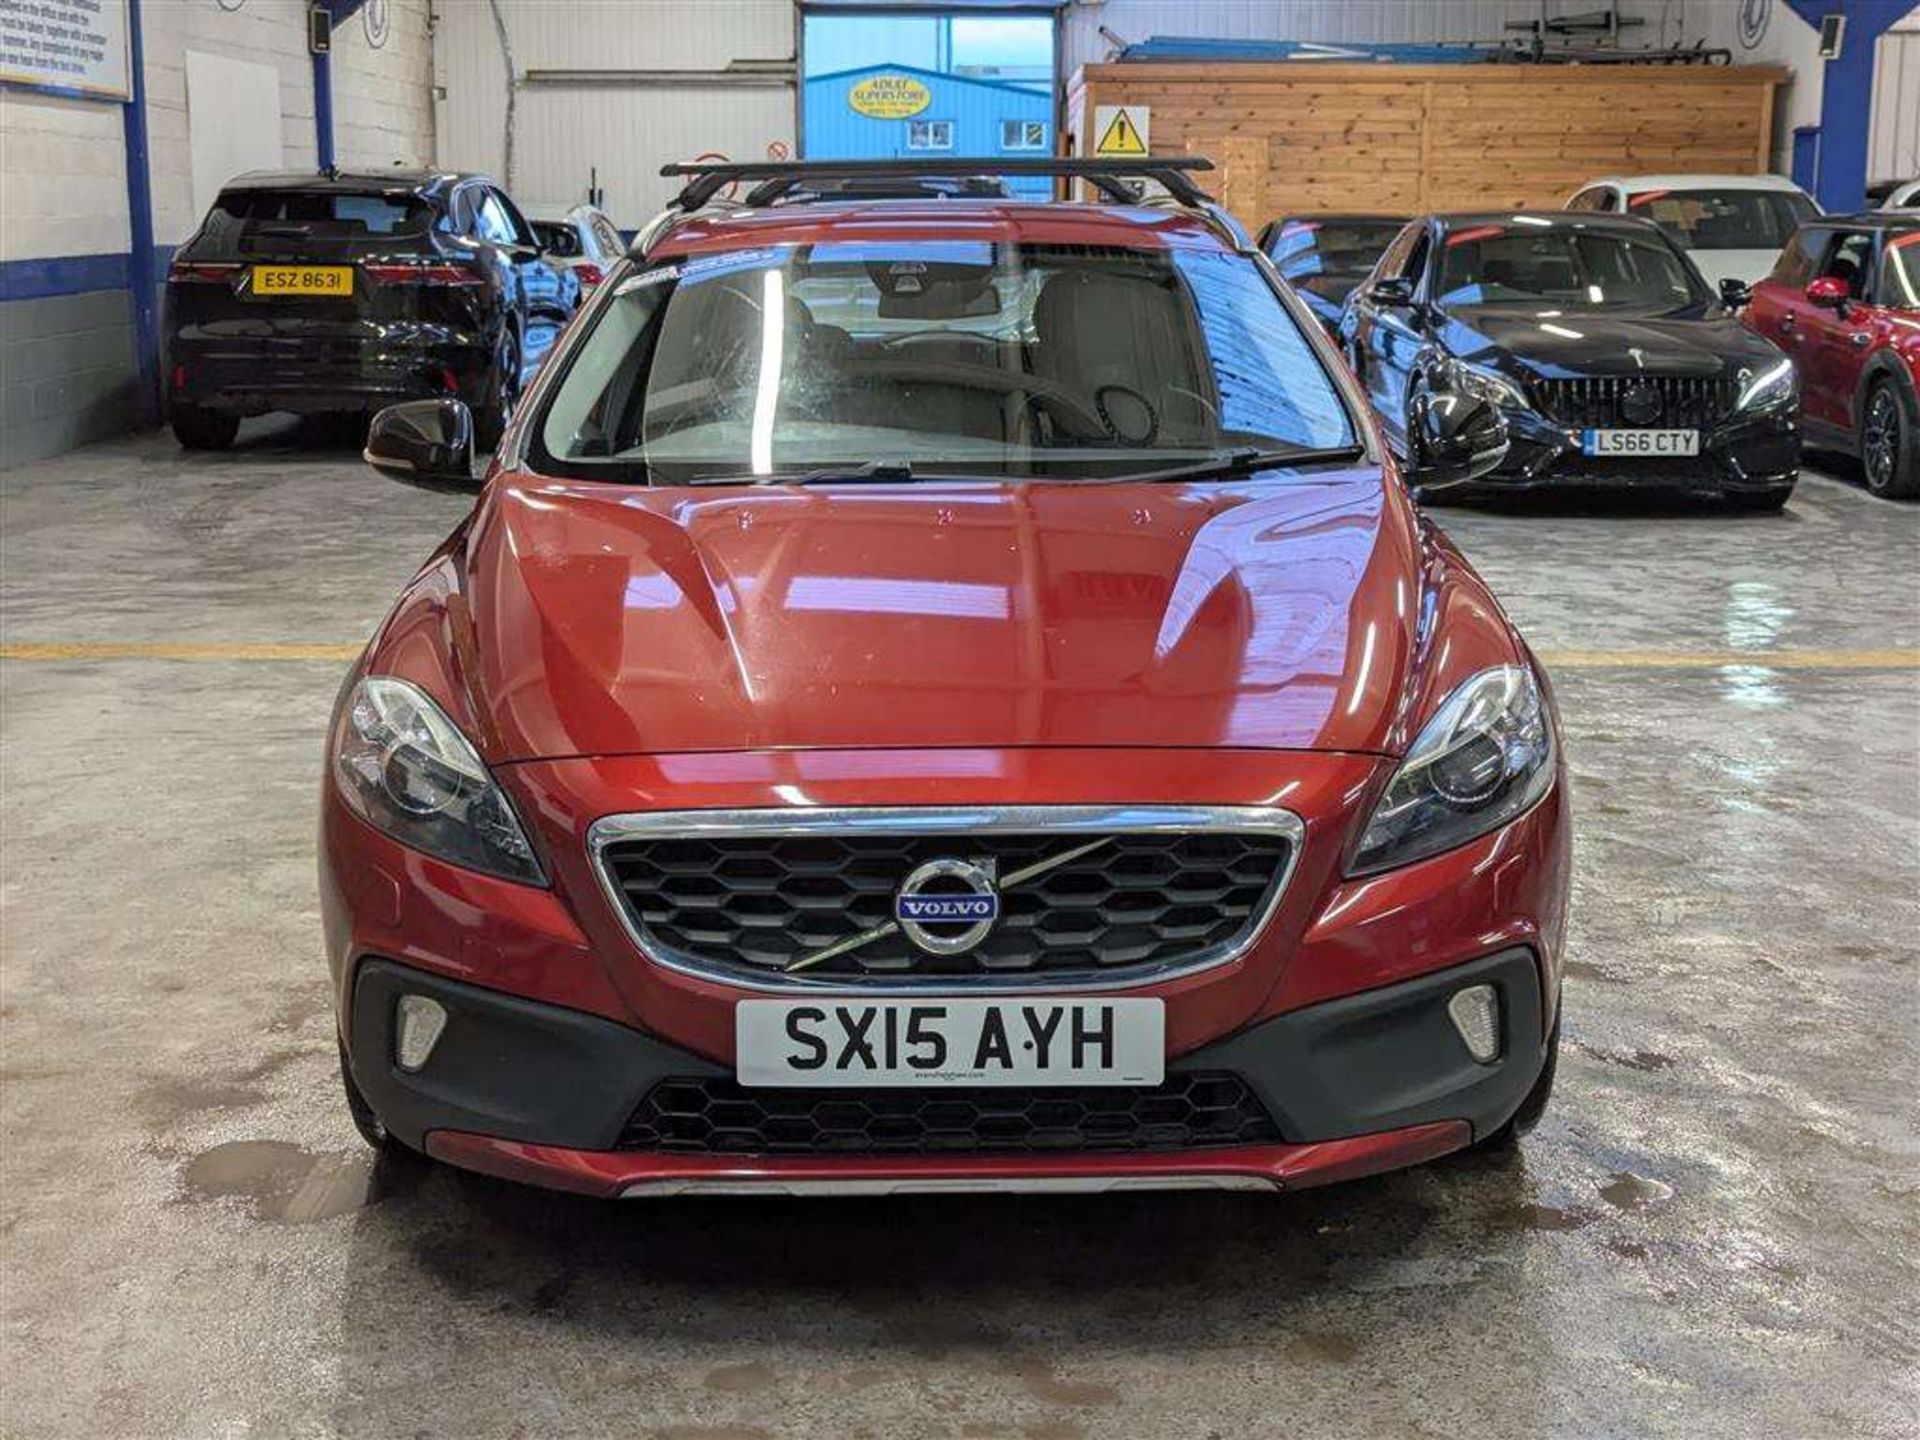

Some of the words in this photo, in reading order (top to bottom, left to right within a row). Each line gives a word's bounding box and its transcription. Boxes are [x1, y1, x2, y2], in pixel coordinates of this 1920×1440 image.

[265, 272, 298, 287] ESZ
[303, 272, 341, 288] 8631
[1598, 433, 1650, 451] LS66
[1655, 433, 1695, 451] CTY
[904, 901, 990, 915] VOLVO
[785, 1006, 948, 1070] SX15
[973, 1006, 1114, 1070] AYH
